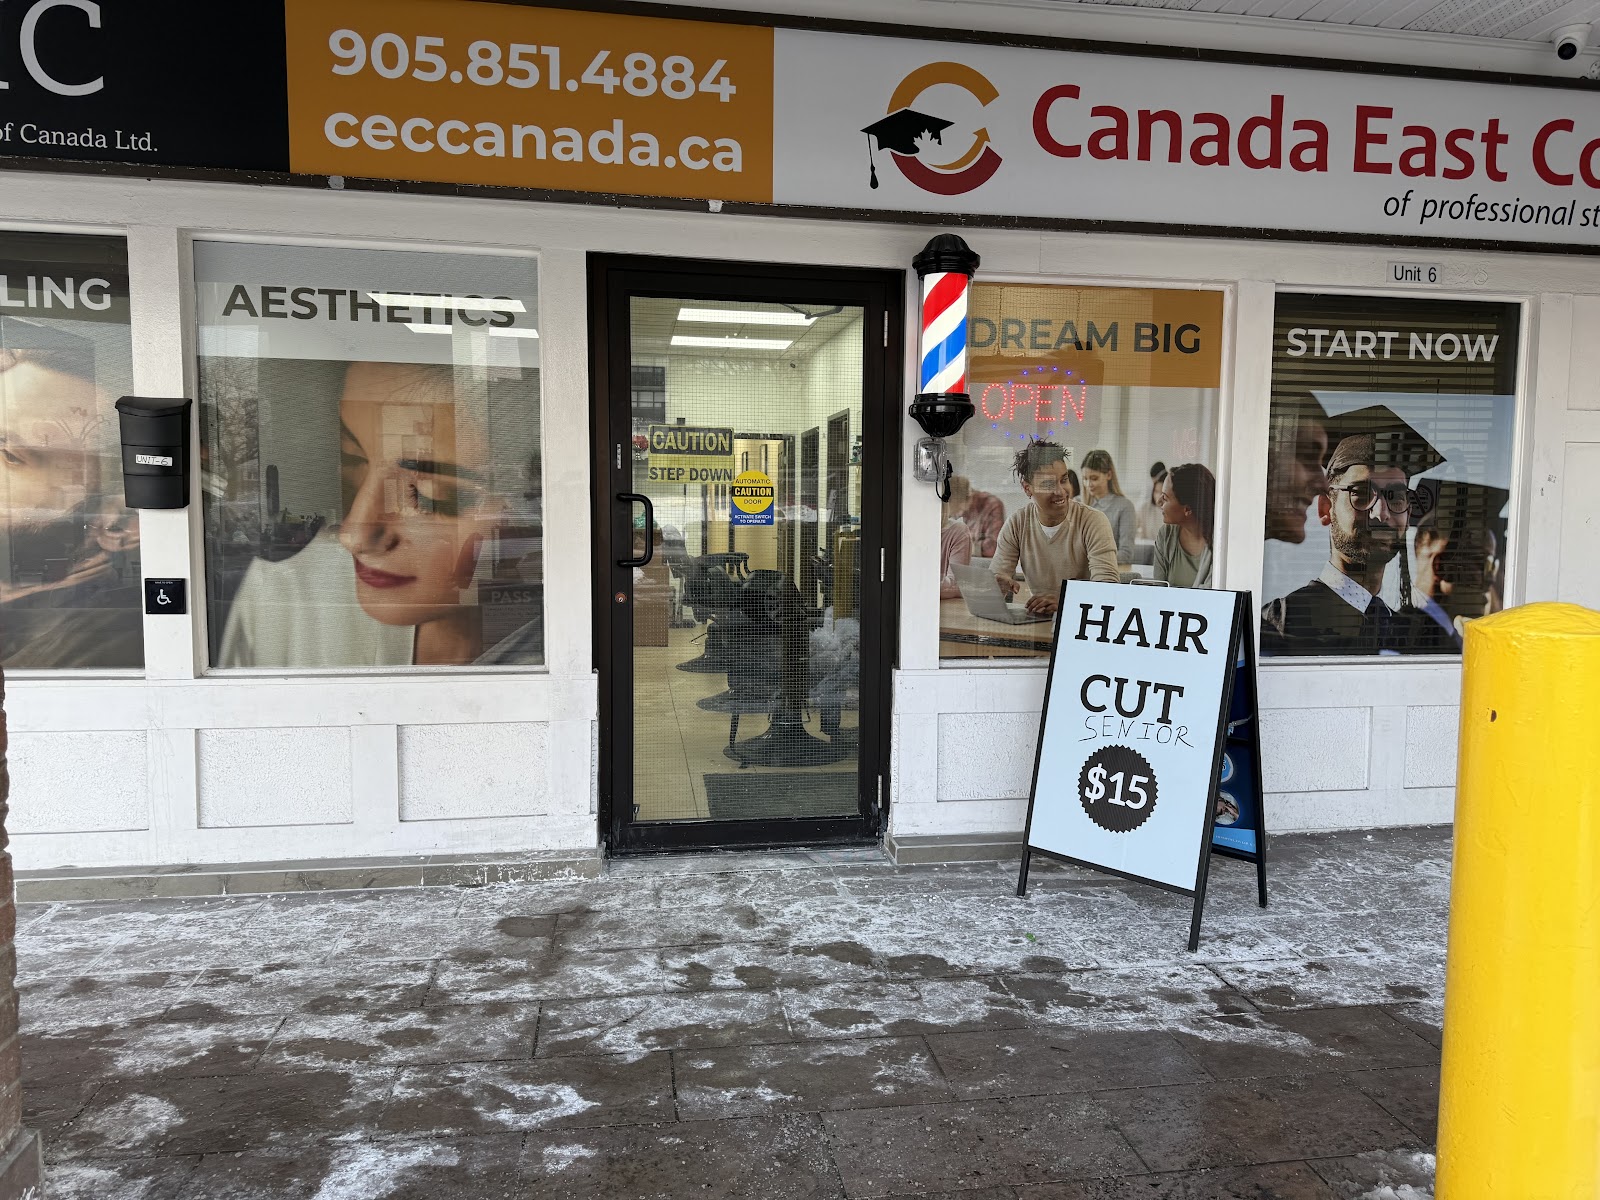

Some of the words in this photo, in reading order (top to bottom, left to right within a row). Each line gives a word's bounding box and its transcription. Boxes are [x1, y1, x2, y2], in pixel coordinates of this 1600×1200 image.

[0, 0, 104, 96] C
[328, 29, 737, 102] 905.851.4884
[20, 123, 108, 148] Canada
[115, 130, 158, 152] Ltd.
[324, 112, 743, 172] ceccanada.ca
[1032, 84, 1330, 172] Canada
[1353, 104, 1509, 182] East
[1383, 189, 1414, 217] of
[1419, 193, 1577, 226] professional
[0, 274, 112, 311] LING
[1393, 265, 1421, 282] Unit
[1428, 266, 1437, 283] 6
[222, 284, 515, 328] AESTHETICS
[968, 318, 1119, 352] DREAM
[1133, 322, 1201, 354] BIG
[1286, 327, 1399, 359] START
[1408, 332, 1500, 362] NOW
[981, 383, 1087, 422] OPEN
[652, 431, 730, 452] CAUTION
[136, 455, 169, 466] UNIT-6
[649, 467, 685, 481] STEP
[689, 468, 732, 482] DOWN
[734, 487, 772, 496] CAUTION
[491, 590, 532, 604] PASS
[1074, 603, 1209, 655] HAIR
[1080, 674, 1184, 725] CUT
[1077, 715, 1195, 749] SENIOR
[1085, 763, 1149, 810] $15
